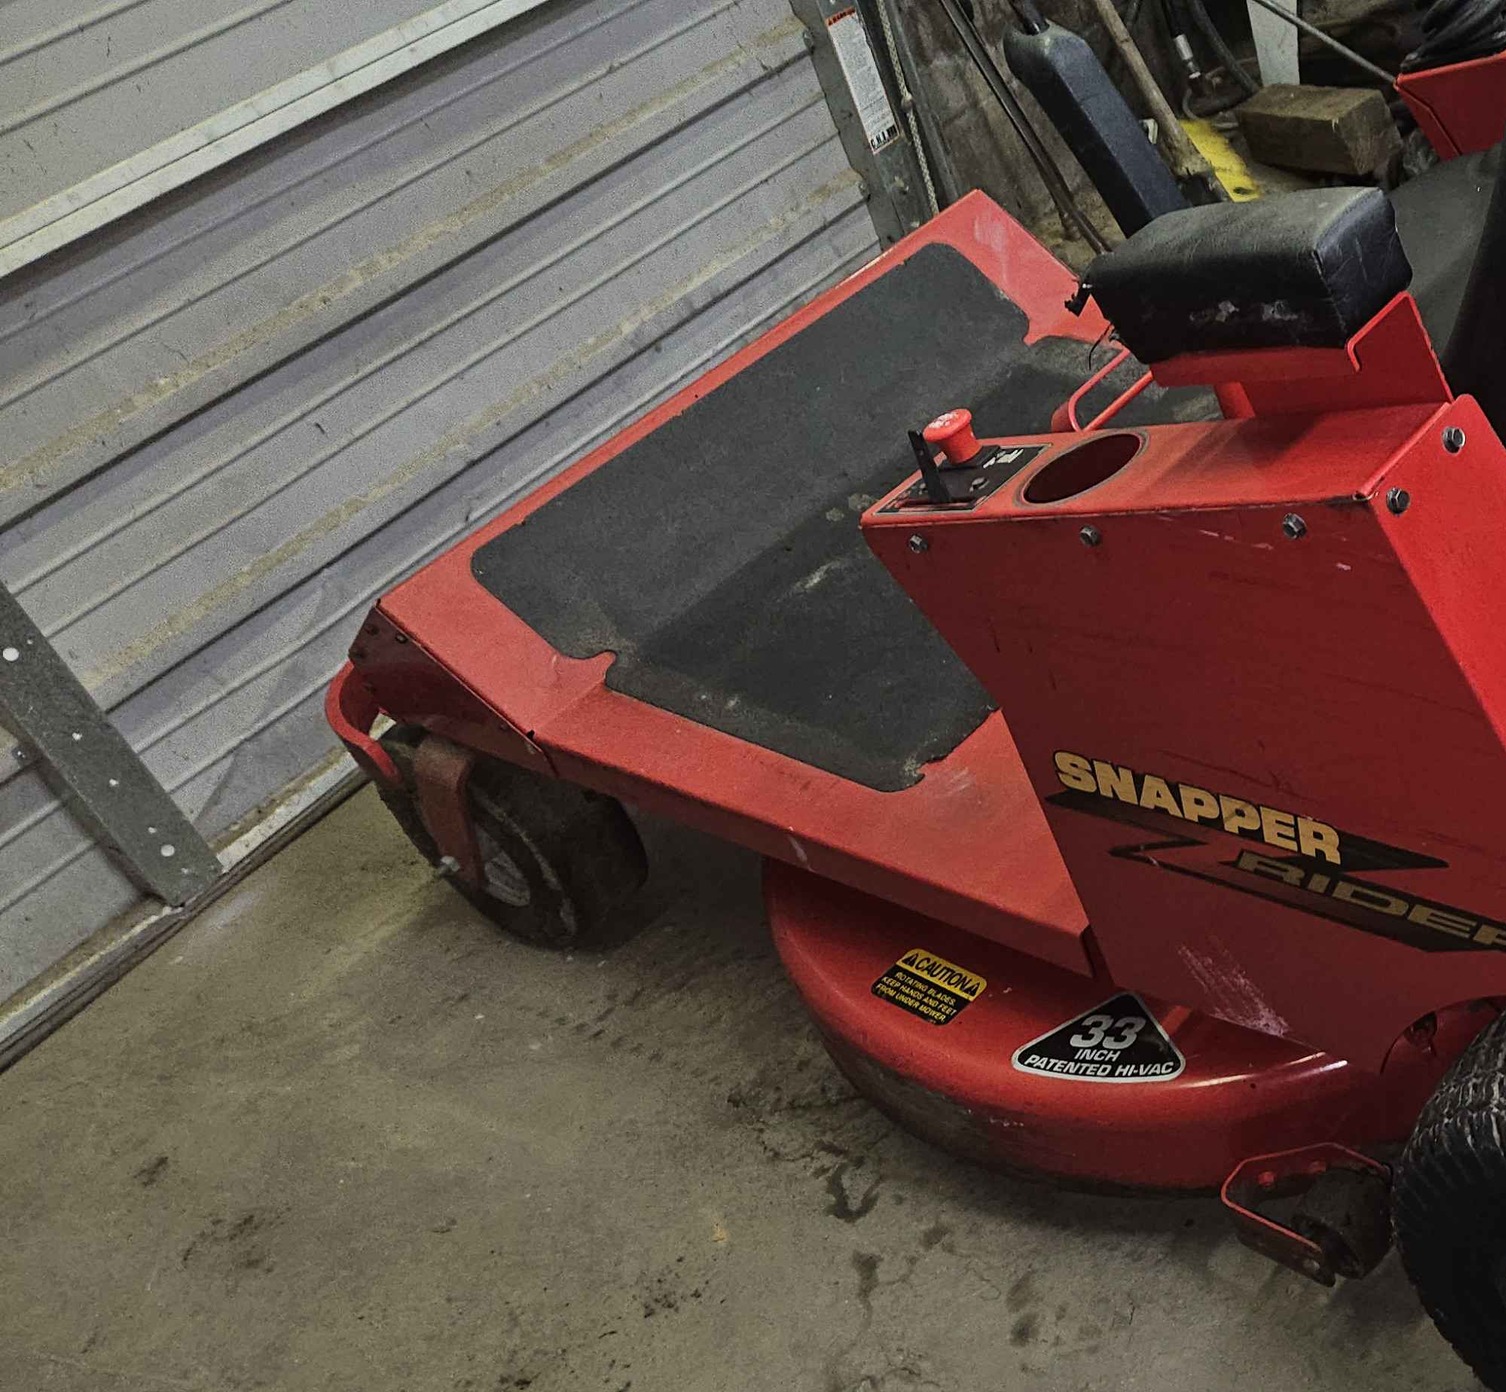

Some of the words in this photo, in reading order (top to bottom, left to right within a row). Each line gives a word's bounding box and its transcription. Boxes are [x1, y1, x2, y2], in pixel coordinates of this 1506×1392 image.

[1053, 750, 1342, 865] SNAPPER
[895, 972, 929, 992] ROTATING
[916, 957, 973, 992] CAUTION
[875, 983, 897, 997] FROM
[896, 993, 920, 1009] UNDER
[882, 976, 902, 989] KEEP
[900, 985, 925, 1000] HANDS
[922, 997, 940, 1008] AND
[937, 1003, 957, 1016] FEET
[1069, 1014, 1147, 1050] 33
[1024, 1054, 1112, 1077] PATENTED
[1114, 1061, 1175, 1077] HI-VAC
[1073, 1049, 1121, 1062] INCH
